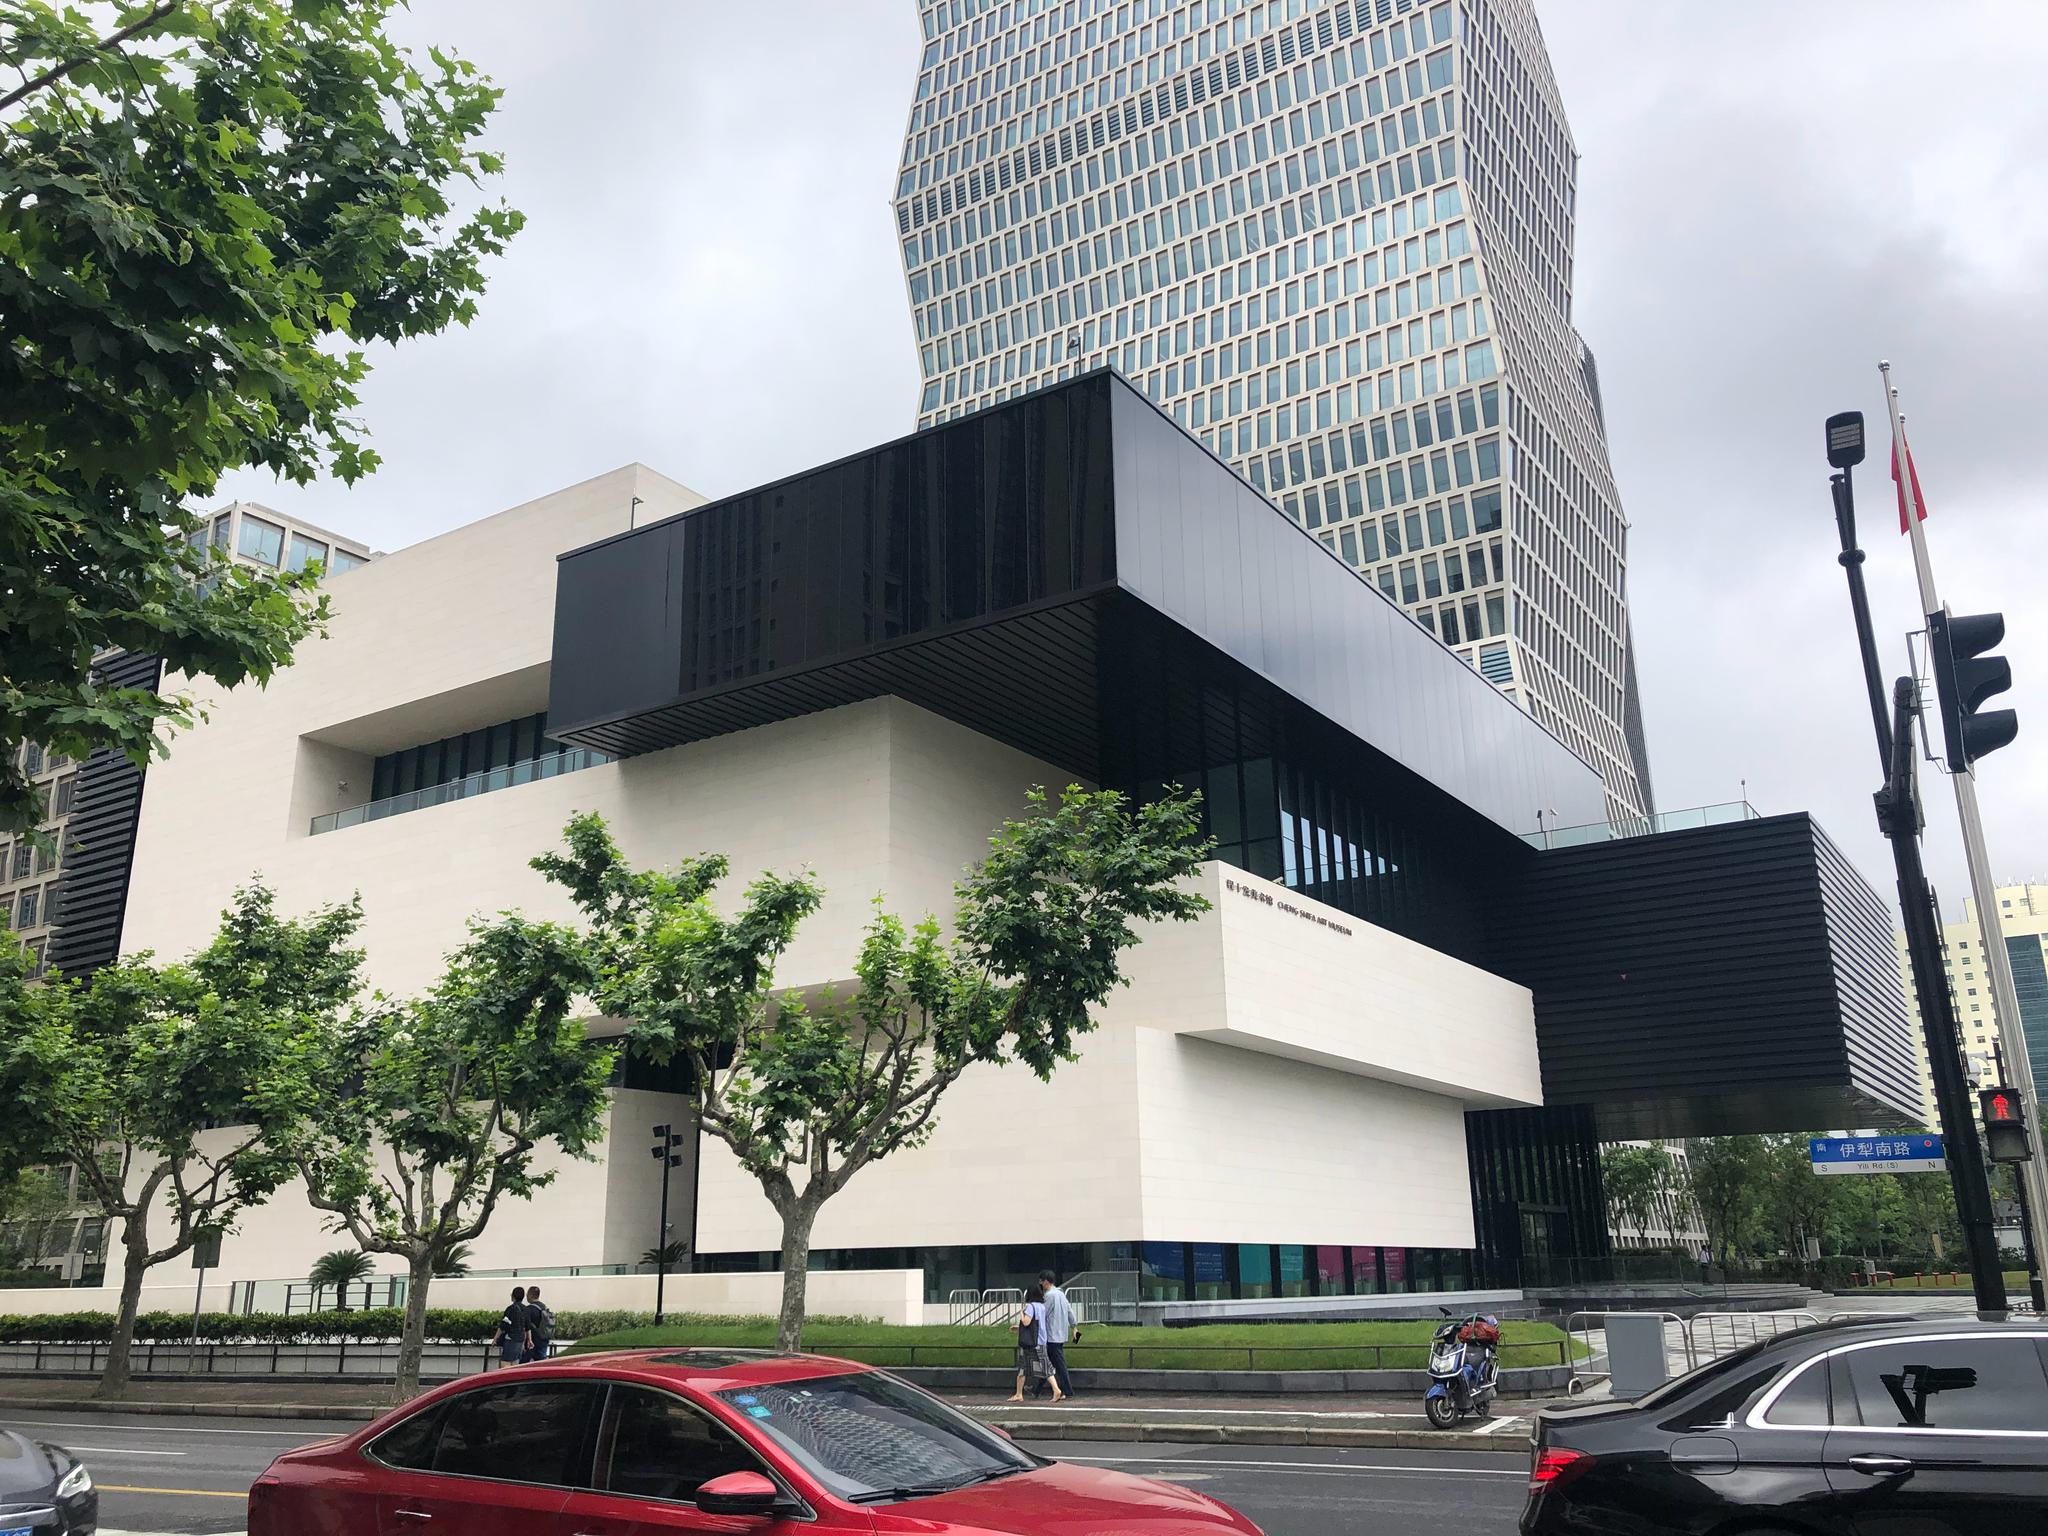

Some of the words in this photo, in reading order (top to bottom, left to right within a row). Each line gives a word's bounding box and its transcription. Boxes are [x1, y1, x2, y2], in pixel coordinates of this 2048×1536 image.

[1277, 901, 1299, 916] CHENG
[1328, 921, 1352, 936] MUSEUM
[1816, 1143, 1827, 1152] 南
[1840, 1141, 1911, 1158] 伊犁南路
[1821, 1164, 1828, 1172] S
[1928, 1161, 1936, 1169] N
